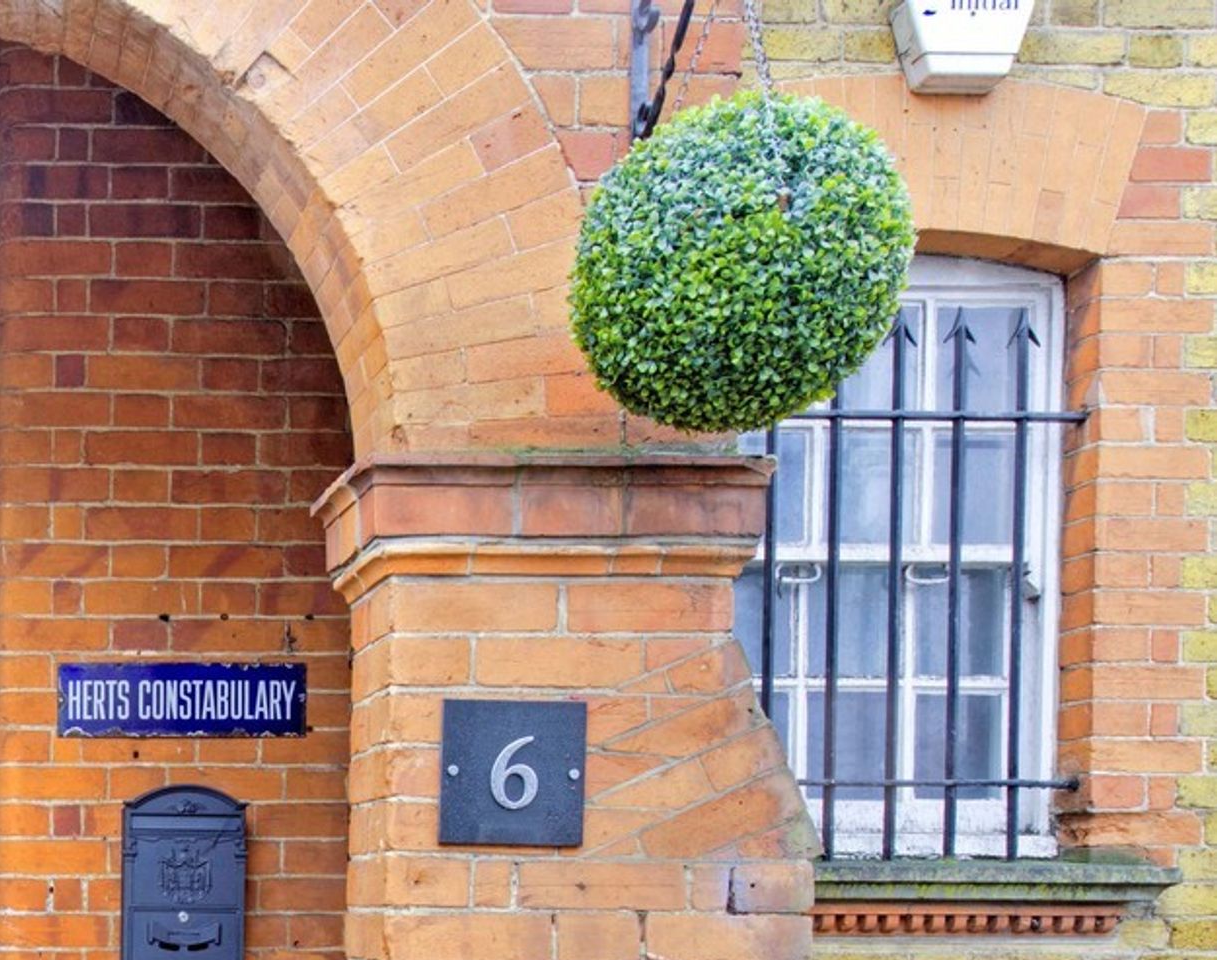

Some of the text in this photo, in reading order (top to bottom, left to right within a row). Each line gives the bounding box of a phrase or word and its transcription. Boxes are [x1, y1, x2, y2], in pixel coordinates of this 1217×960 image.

[68, 680, 297, 721] HERTS CONSTABULARY
[490, 735, 539, 810] 6
